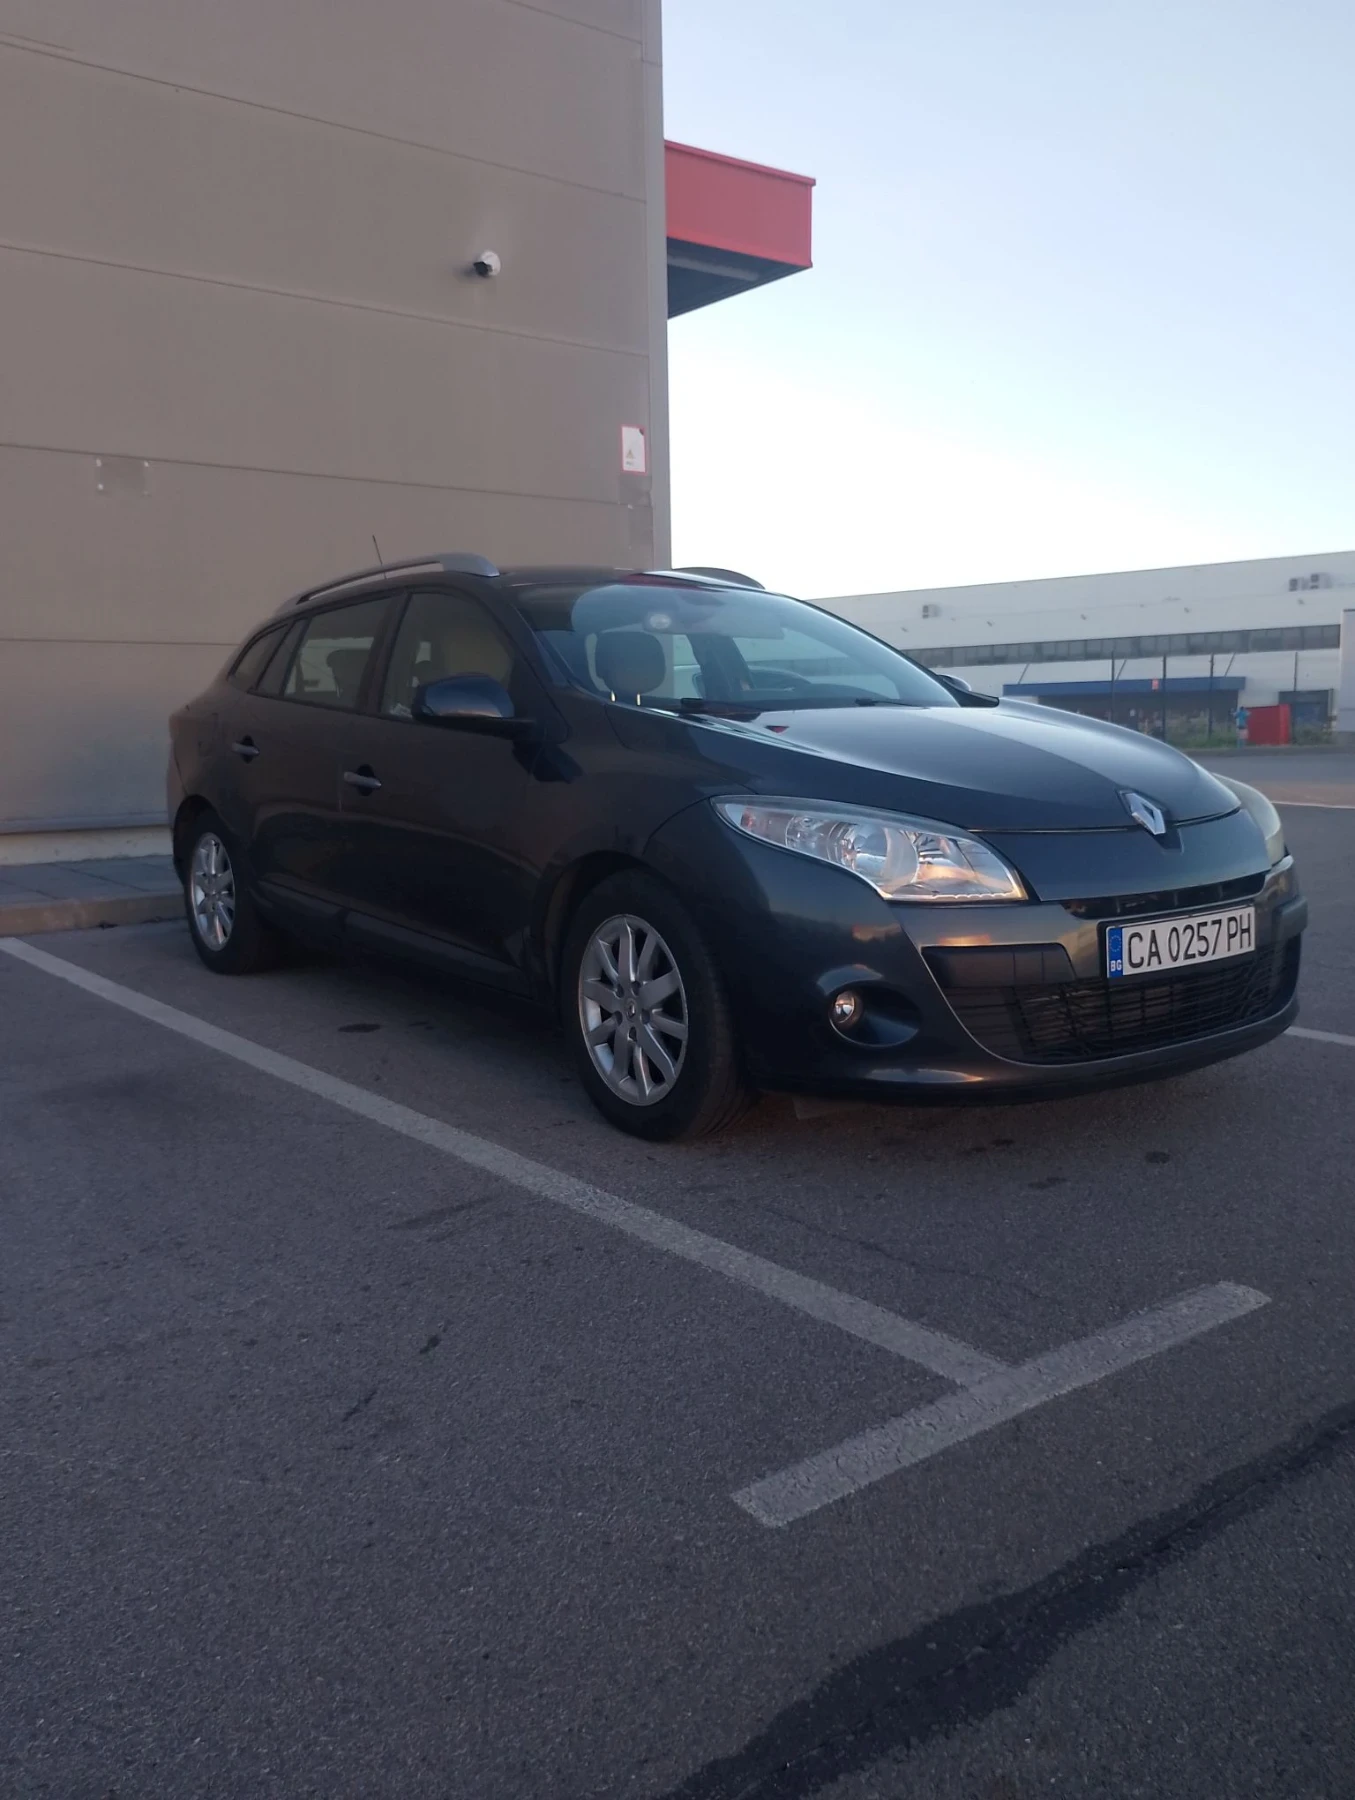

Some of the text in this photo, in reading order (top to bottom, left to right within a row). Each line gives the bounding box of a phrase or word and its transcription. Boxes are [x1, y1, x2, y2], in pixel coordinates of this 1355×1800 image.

[1127, 913, 1252, 969] CA 0257 PH
[1110, 959, 1122, 972] BG
